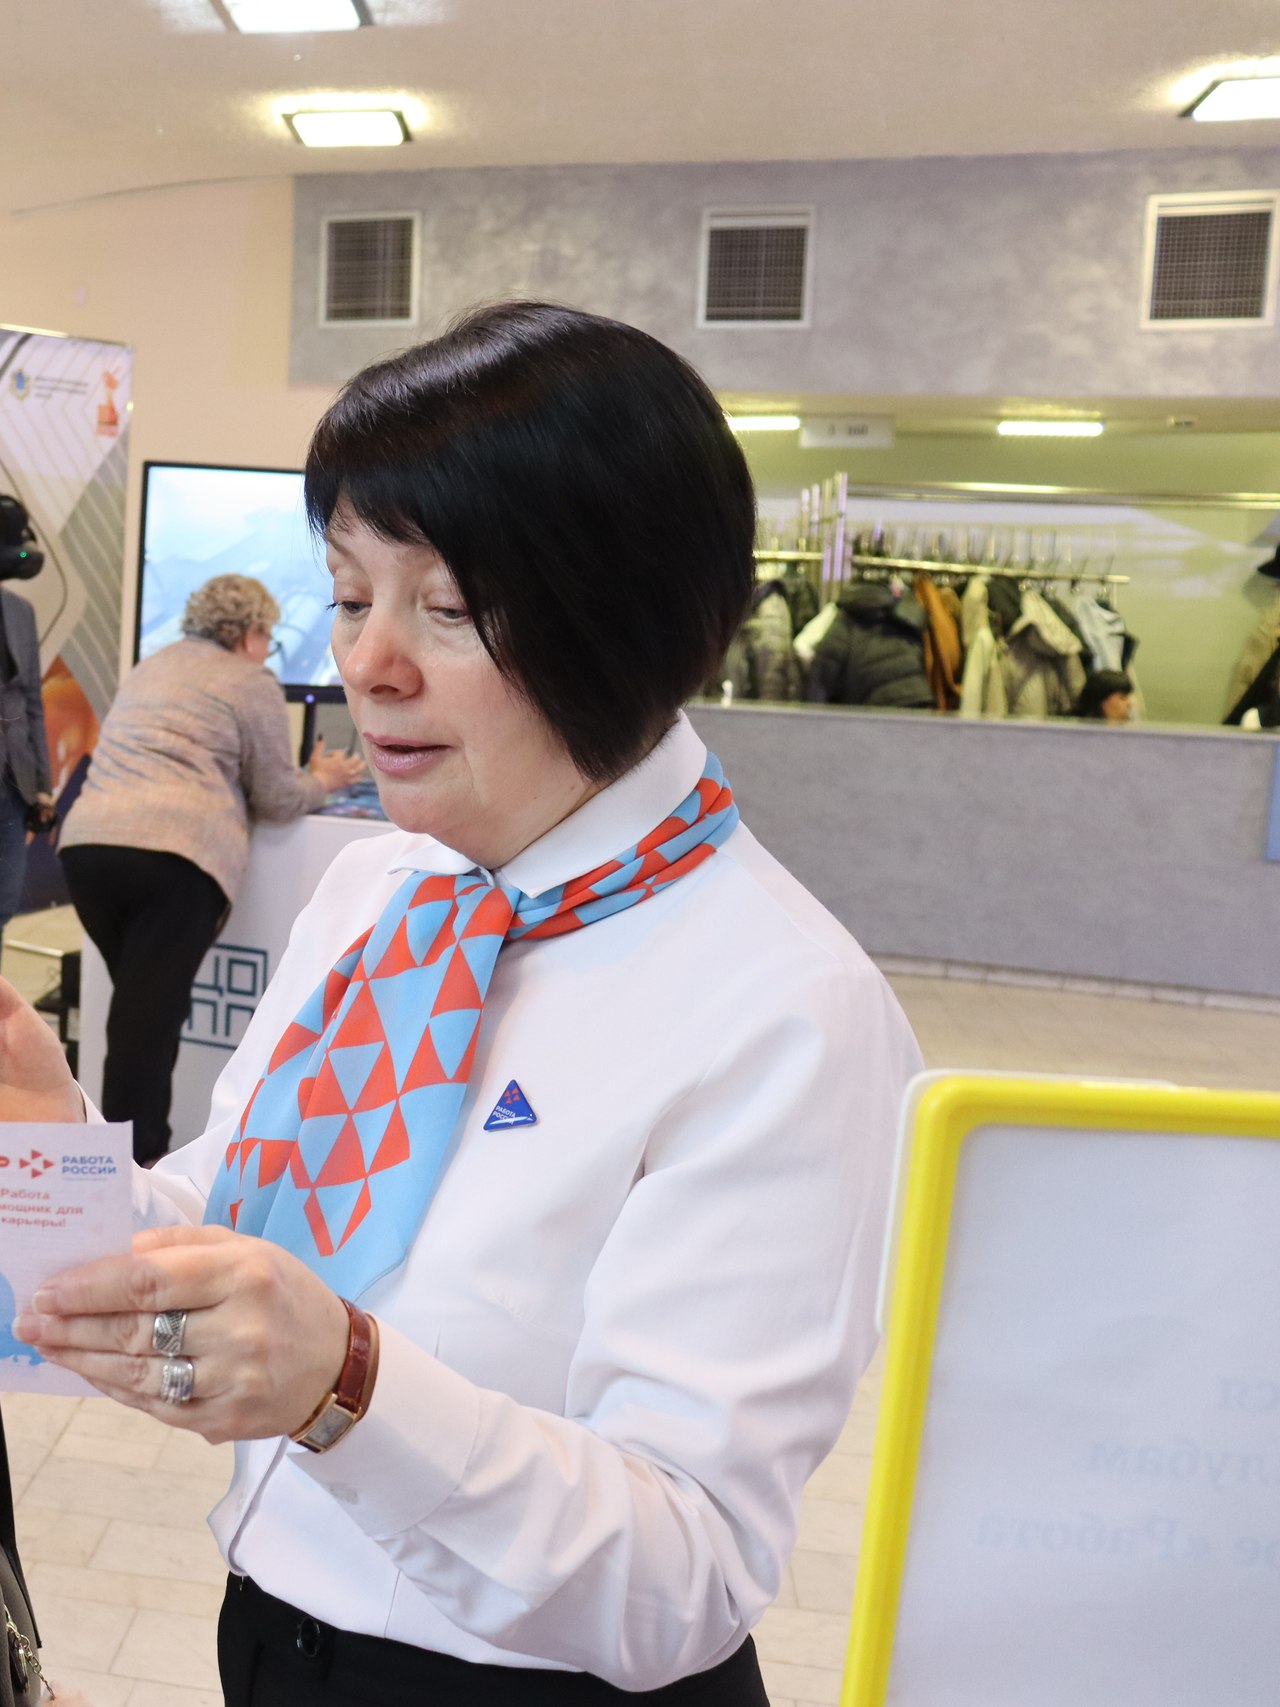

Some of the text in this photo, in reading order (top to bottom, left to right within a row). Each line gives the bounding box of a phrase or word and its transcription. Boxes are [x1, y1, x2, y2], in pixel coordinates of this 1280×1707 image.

[61, 1155, 114, 1165] РАБОТА
[61, 1166, 117, 1175] РОССИИ
[55, 1205, 84, 1215] для
[1, 1215, 66, 1228] карьеры!
